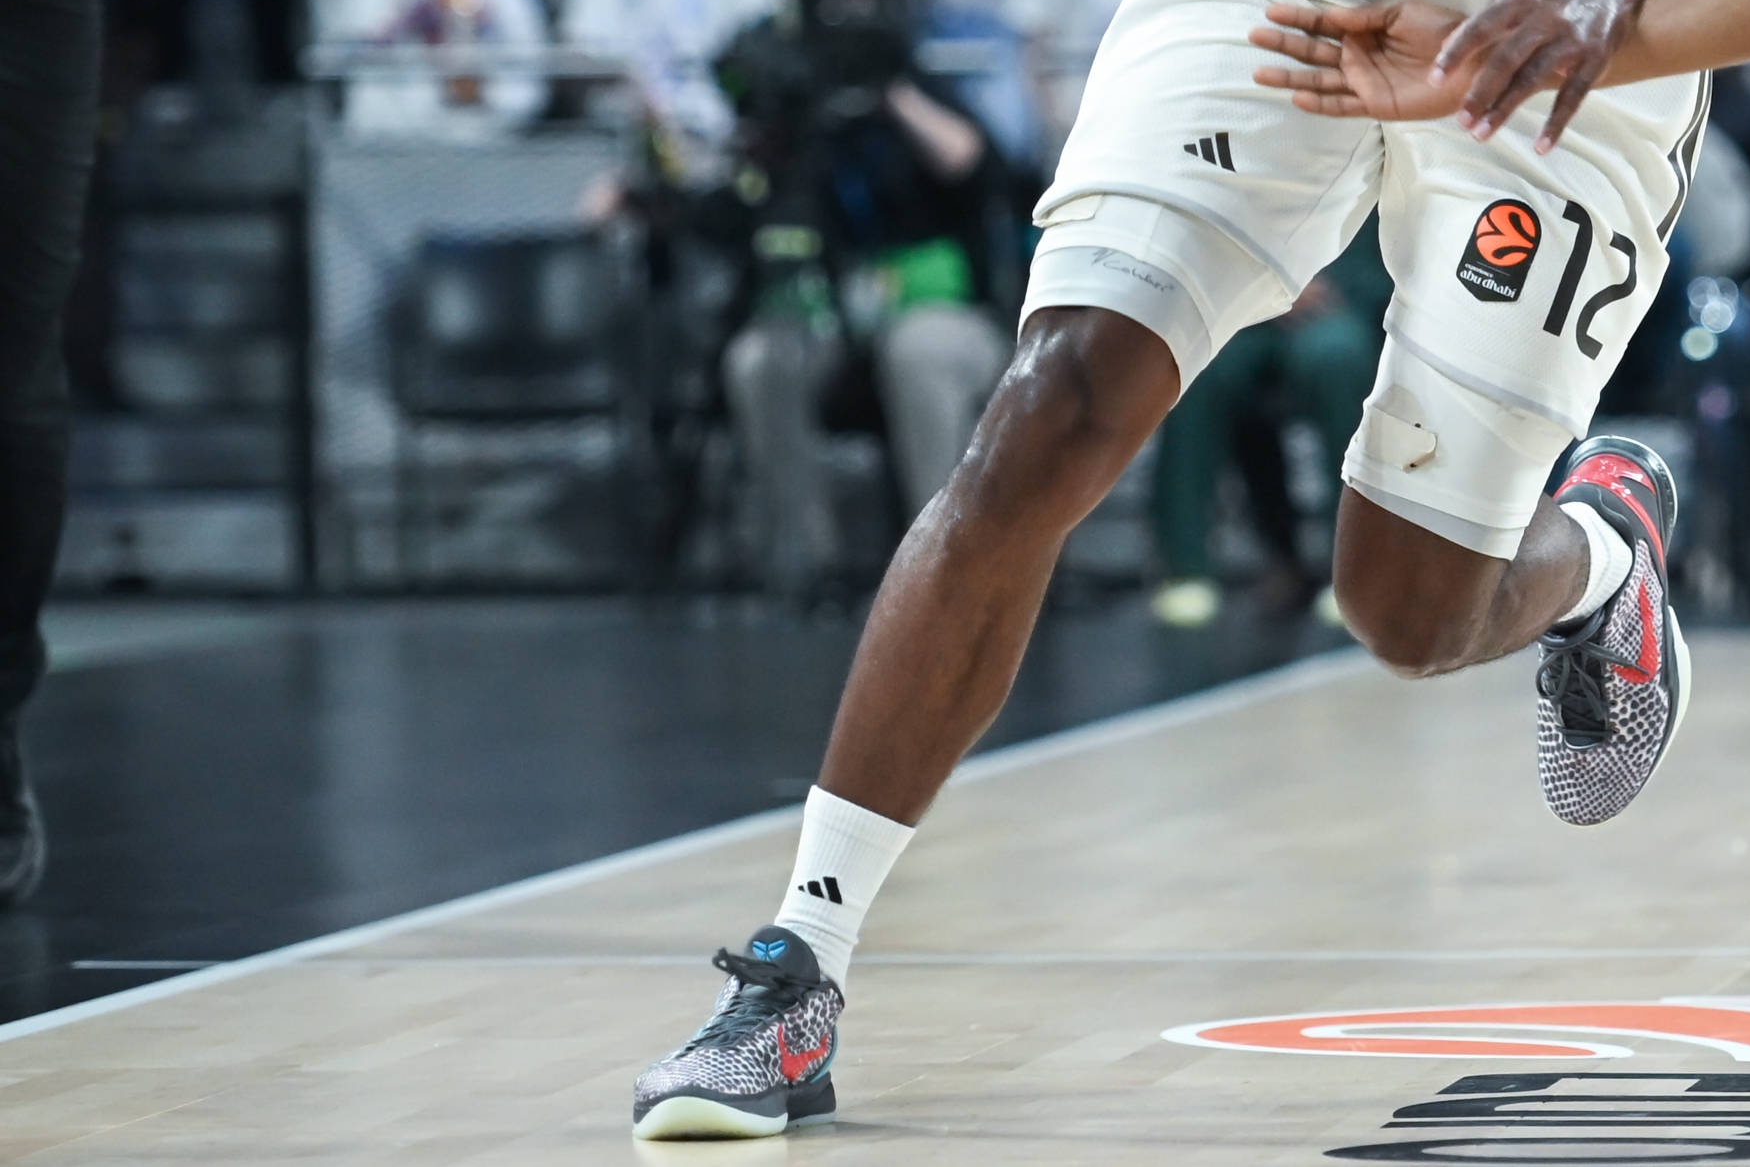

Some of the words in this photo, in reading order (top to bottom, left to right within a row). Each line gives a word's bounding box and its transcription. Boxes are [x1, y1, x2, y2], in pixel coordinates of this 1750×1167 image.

[1459, 268, 1482, 286] abu
[1482, 277, 1518, 300] dhabi
[1542, 199, 1637, 361] 12
